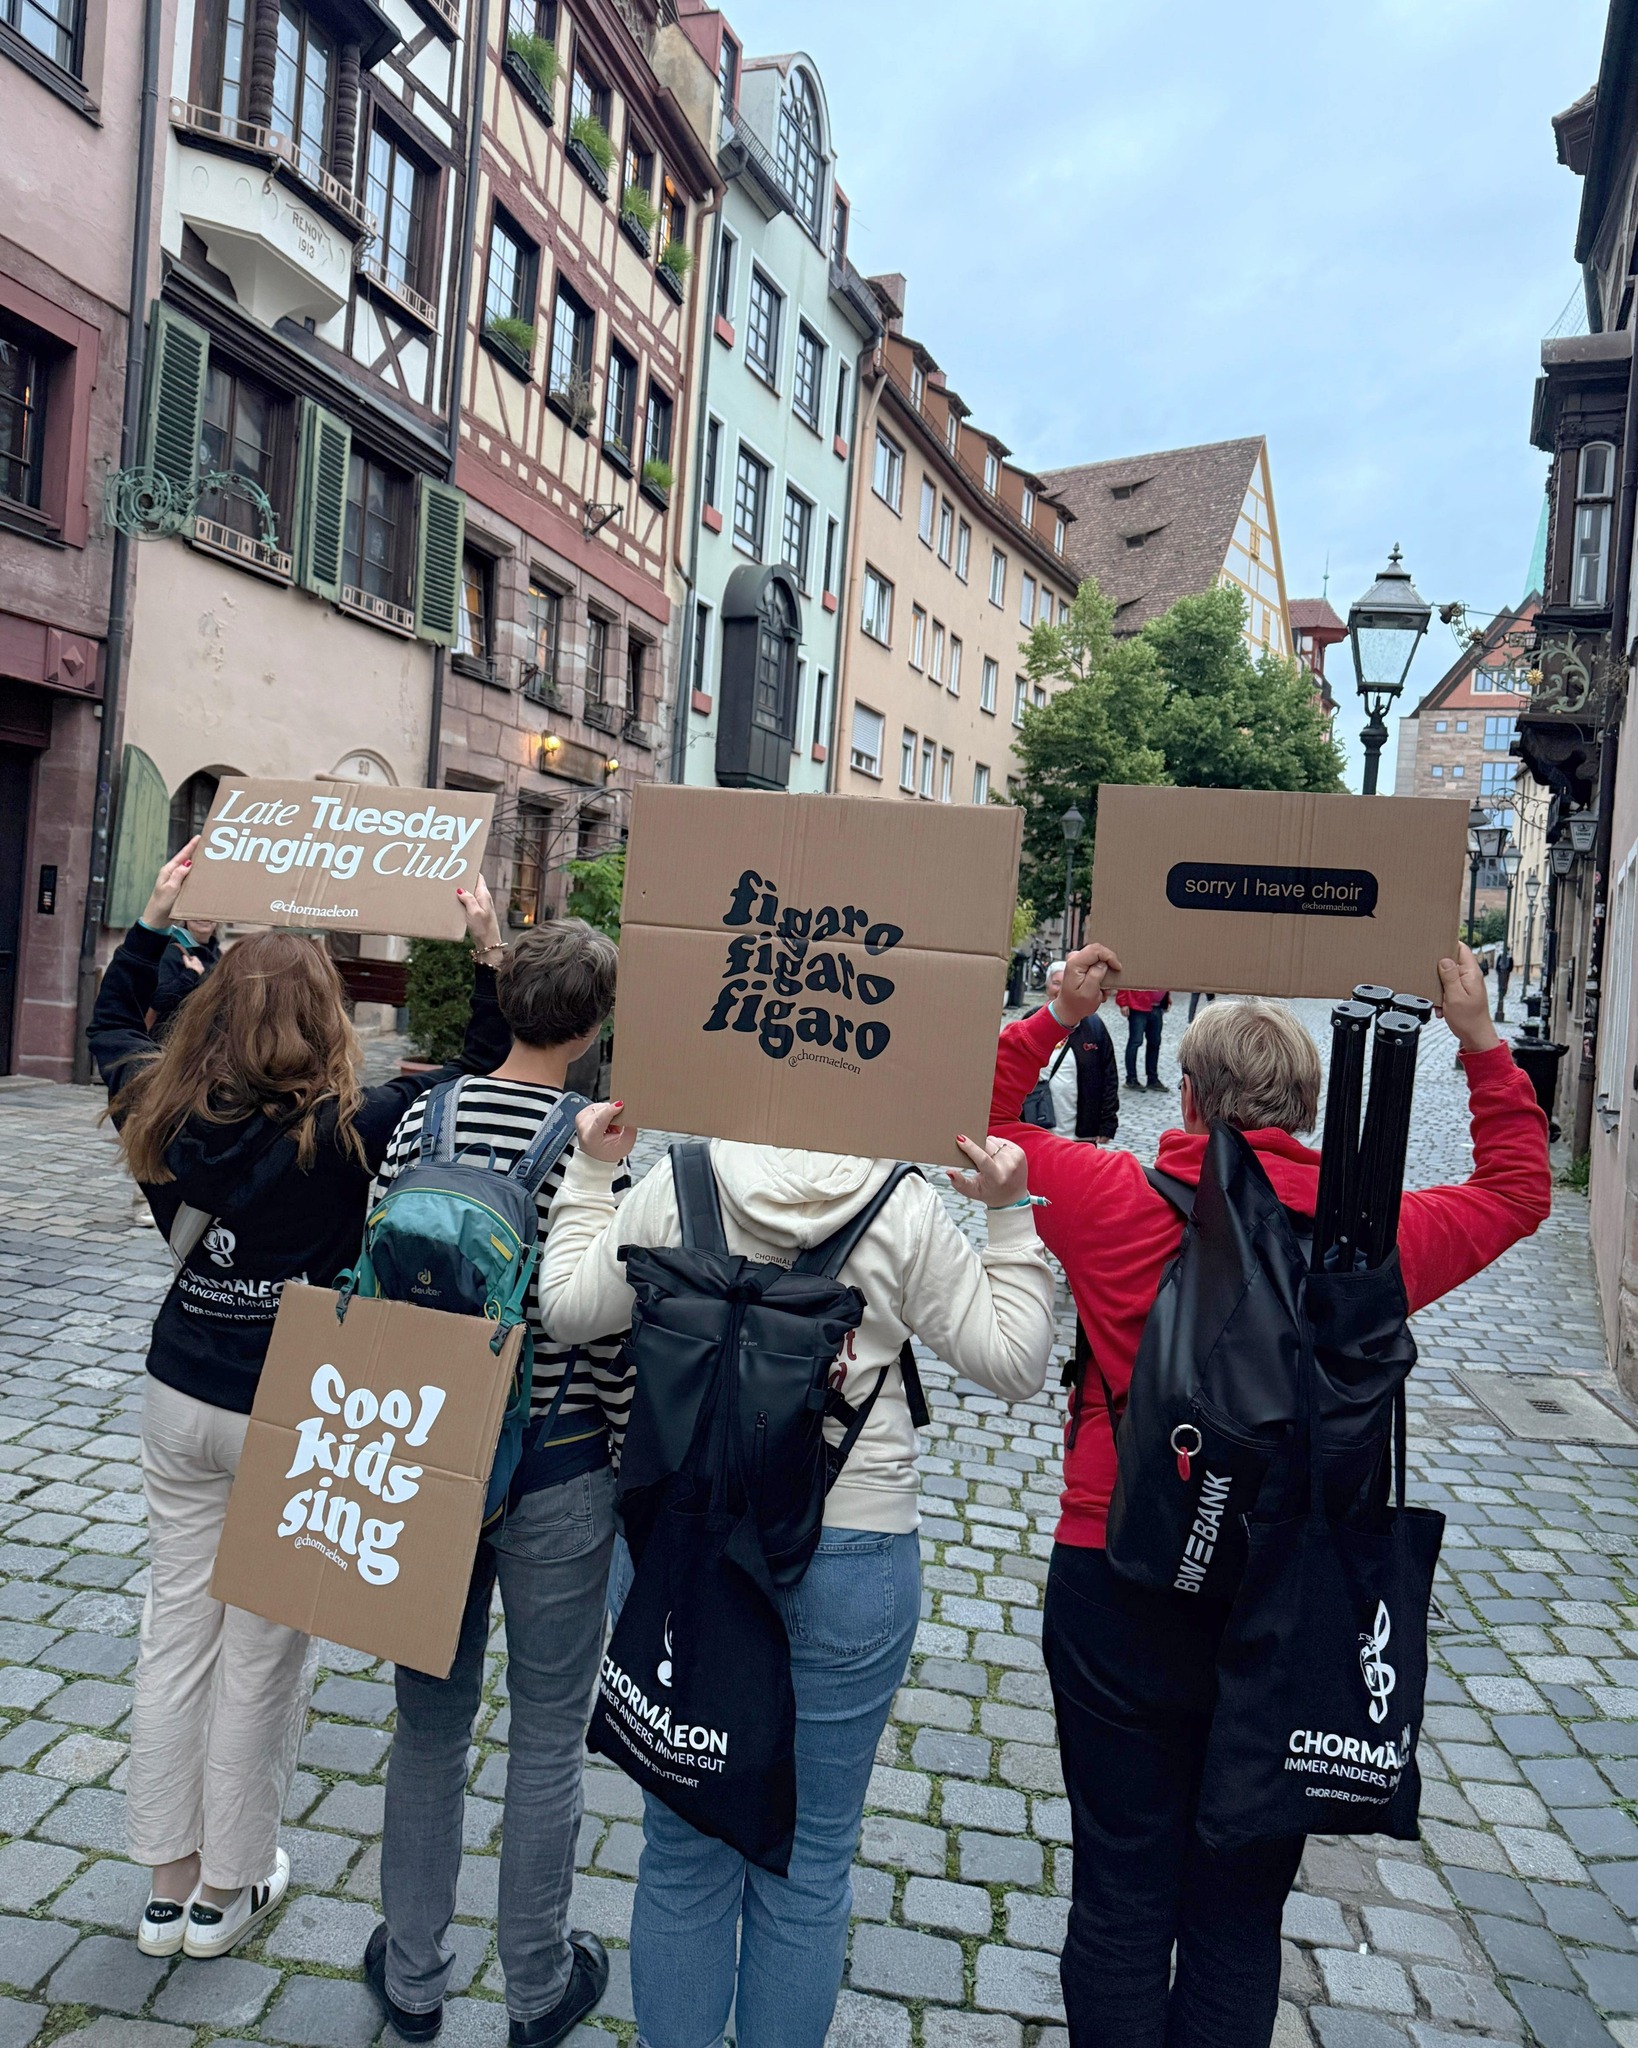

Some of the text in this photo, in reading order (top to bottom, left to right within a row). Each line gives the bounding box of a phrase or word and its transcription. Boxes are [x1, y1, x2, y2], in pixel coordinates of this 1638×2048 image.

[212, 789, 483, 850] Late Tuesday
[204, 826, 469, 881] Singing Club
[269, 899, 359, 918] @chormaeleon
[1184, 878, 1363, 900] sorry I have choir
[1301, 901, 1358, 912] @chormaeleon
[722, 869, 904, 957] figaro
[721, 930, 896, 1006] figaro
[702, 978, 891, 1060] figaro
[787, 1048, 862, 1075] @chormaeleon
[188, 1284, 236, 1306] ANDERS,
[410, 1284, 442, 1297] deuter
[284, 1416, 424, 1505] kids
[277, 1476, 405, 1586] sing
[293, 1533, 348, 1572] @chormaeleon
[604, 1712, 621, 1734] CHOR
[620, 1731, 631, 1748] DER
[651, 1763, 700, 1789] STUTTGART
[619, 1704, 654, 1749] ANDERS,
[655, 1739, 695, 1767] IMMER
[697, 1755, 726, 1773] GUT
[1284, 1758, 1328, 1774] IMMER
[1329, 1763, 1388, 1789] ANDERS,
[1305, 1787, 1331, 1798] CHOR
[1330, 1791, 1350, 1802] DER
[149, 1908, 173, 1918] VEJA
